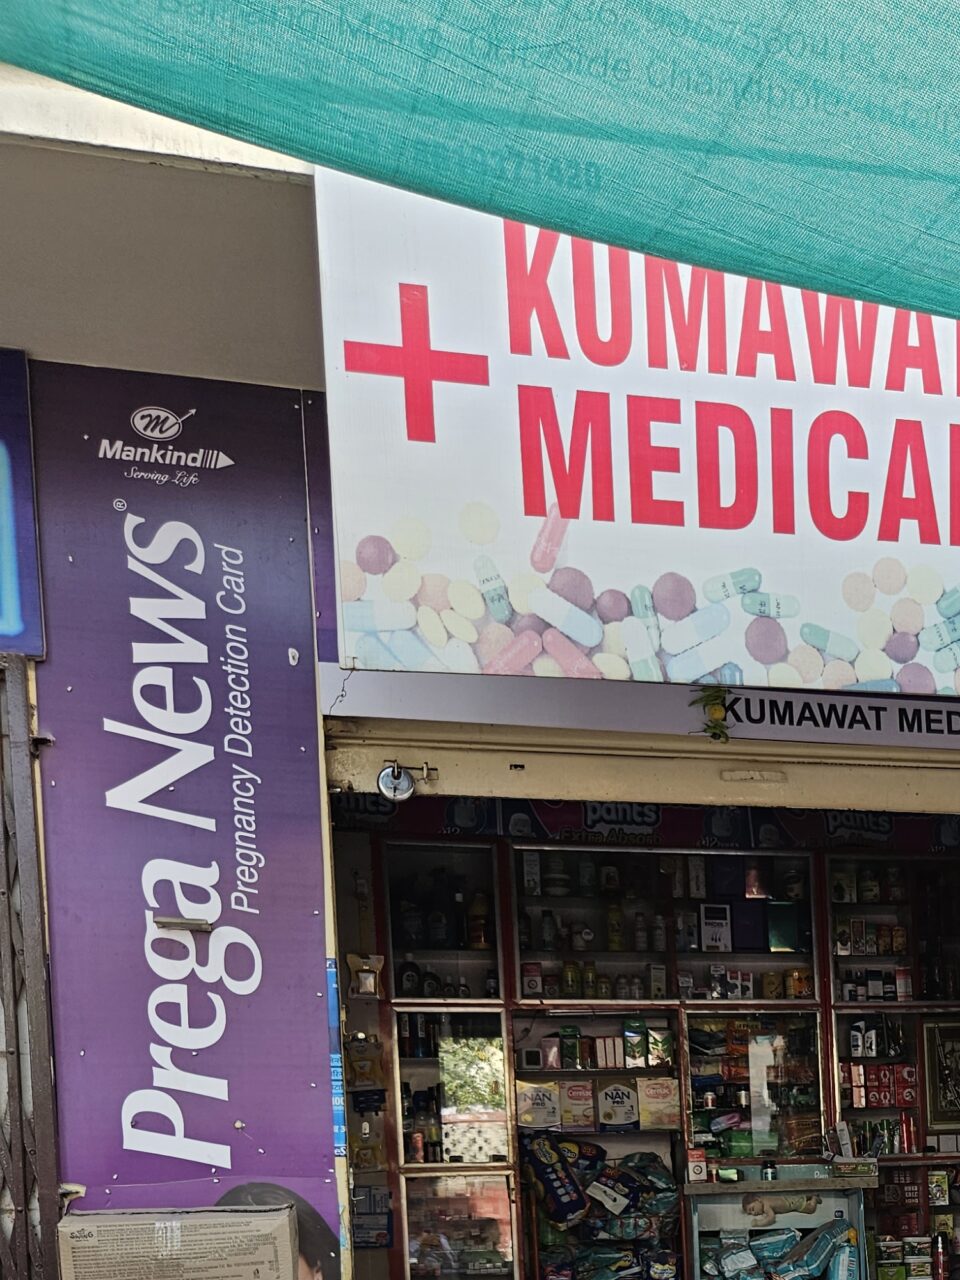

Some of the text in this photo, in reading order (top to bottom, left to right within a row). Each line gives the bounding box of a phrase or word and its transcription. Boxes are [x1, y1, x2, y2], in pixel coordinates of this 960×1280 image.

[98, 438, 204, 468] Mankind
[124, 466, 200, 487] Serving Life
[103, 513, 216, 831] News
[724, 697, 887, 732] KUMAWAT
[214, 544, 266, 914] Pregnancy Detection Card
[584, 801, 660, 827] pants
[560, 828, 605, 843] Extra
[121, 858, 262, 1169] Prega
[524, 1092, 553, 1102] NAN
[604, 1091, 631, 1101] NAN
